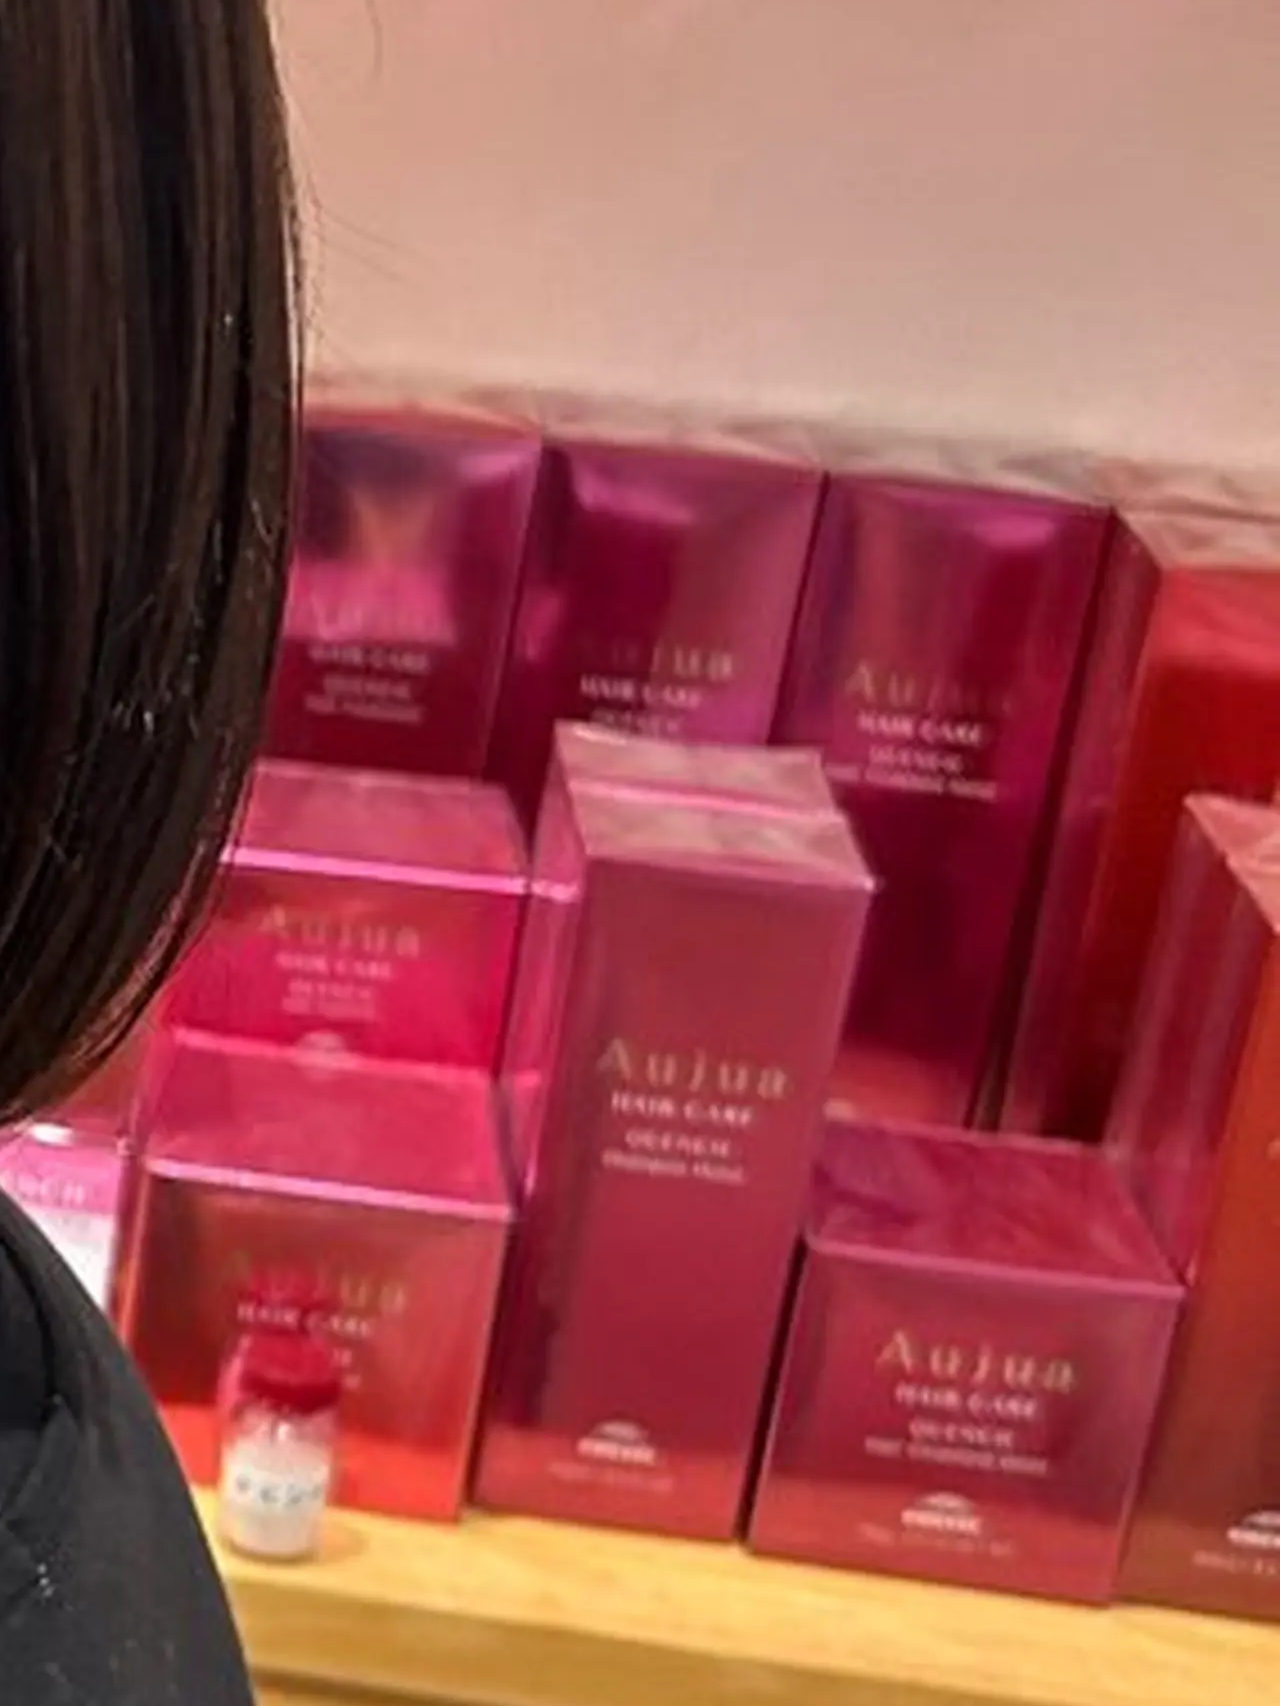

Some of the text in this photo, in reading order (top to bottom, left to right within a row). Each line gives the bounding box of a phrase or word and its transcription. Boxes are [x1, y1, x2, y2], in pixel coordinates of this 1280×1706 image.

[594, 1037, 788, 1100] Aujua
[610, 1089, 753, 1128] HAIR CARE
[874, 1329, 1076, 1394] Aujua
[894, 1380, 1039, 1421] HAIR CARE
